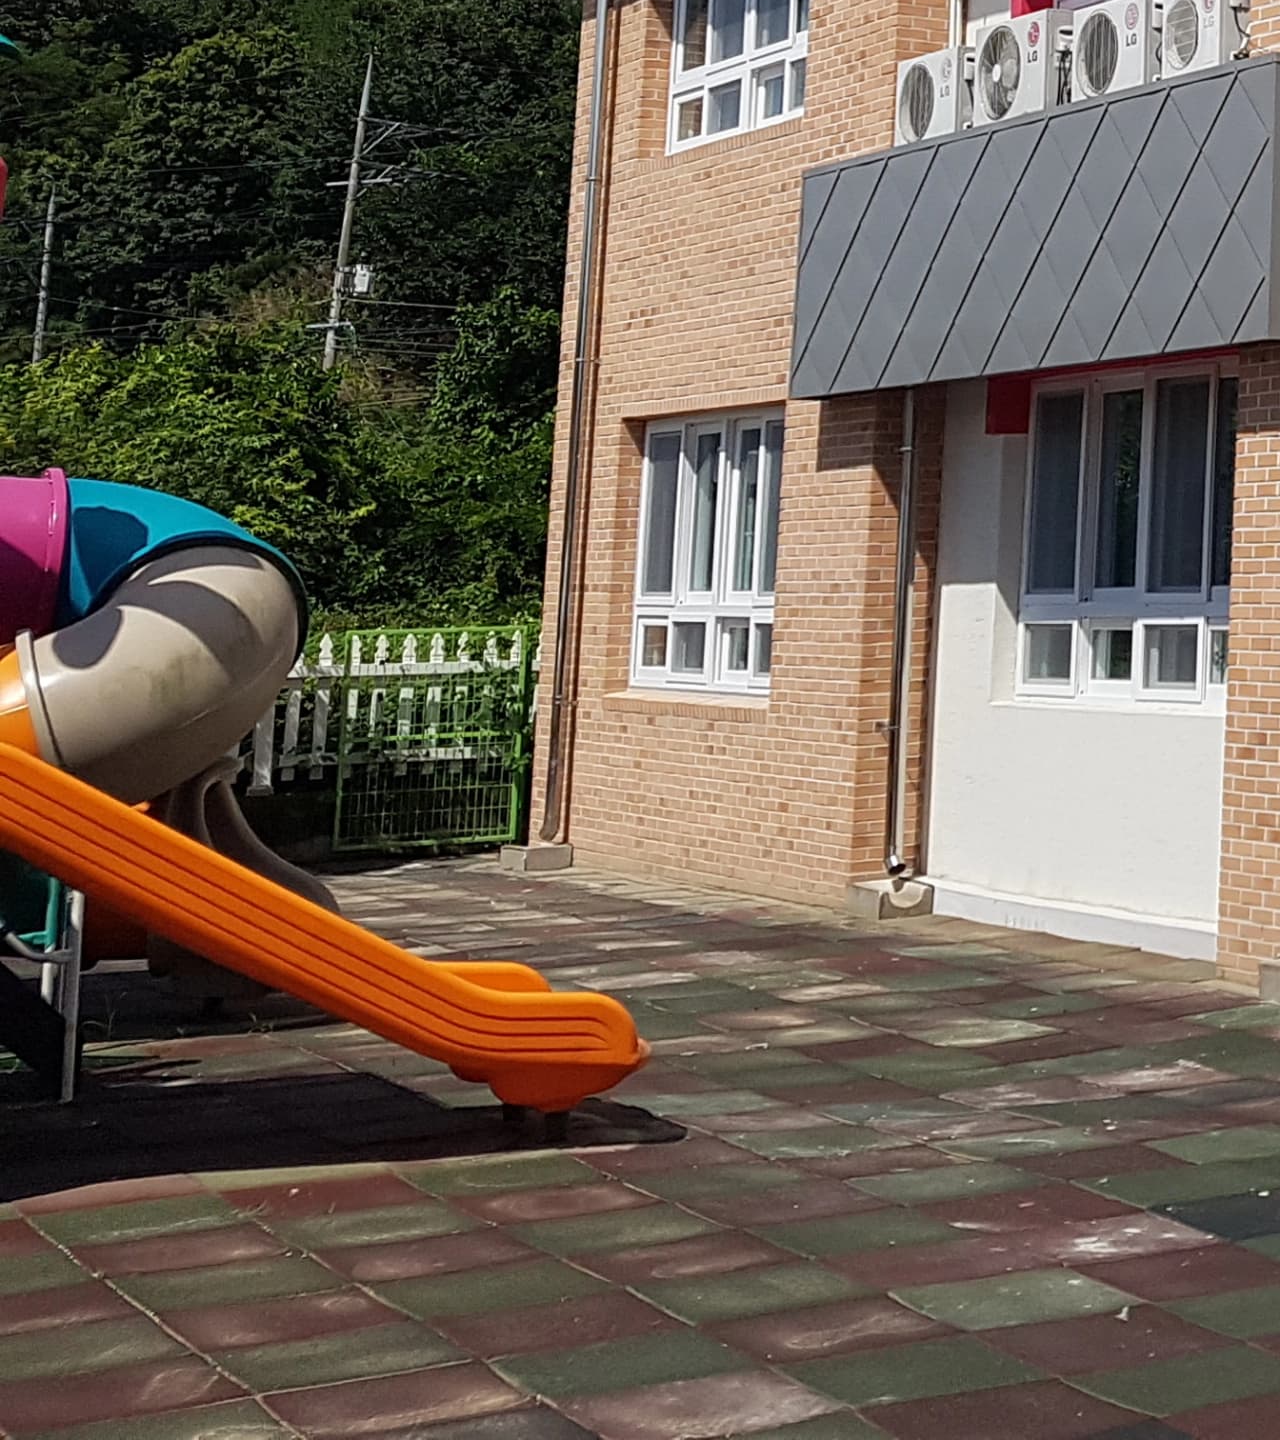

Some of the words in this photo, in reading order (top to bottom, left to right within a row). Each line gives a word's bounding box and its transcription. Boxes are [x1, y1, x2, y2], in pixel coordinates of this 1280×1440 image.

[1203, 15, 1215, 28] LG
[1126, 33, 1137, 47] LG
[1027, 50, 1038, 63] LG
[940, 85, 950, 98] LG
